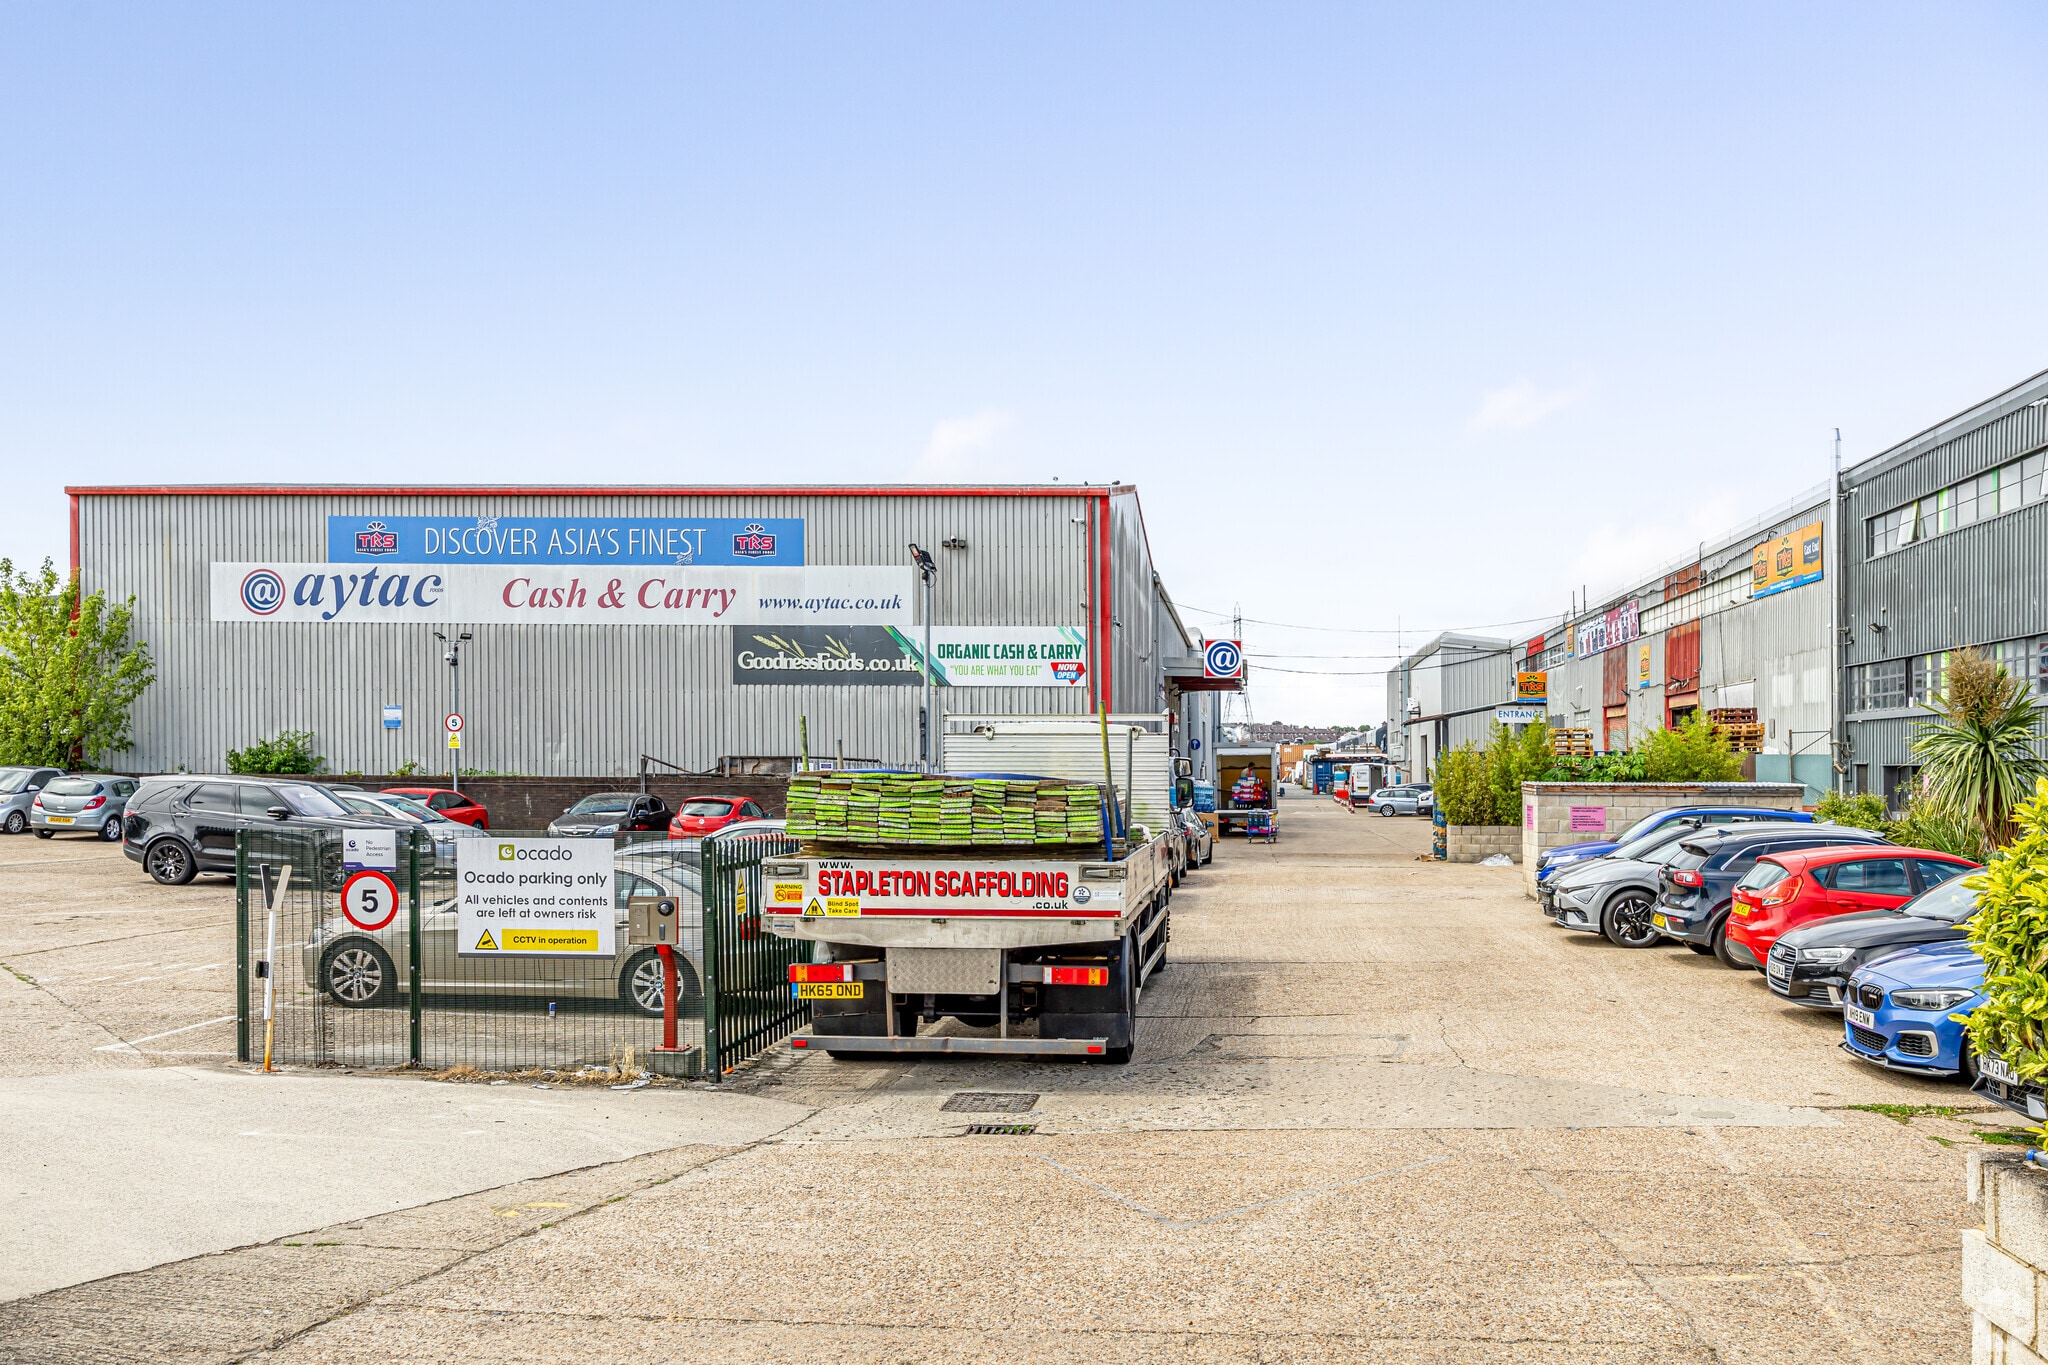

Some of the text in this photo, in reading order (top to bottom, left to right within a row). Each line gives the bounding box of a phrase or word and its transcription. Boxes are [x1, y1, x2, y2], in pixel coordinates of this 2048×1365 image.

[359, 532, 394, 547] TRS
[425, 527, 706, 556] DISCOVER ASIA'S FINEST
[737, 534, 772, 549] TRS
[294, 567, 442, 620] aytac
[503, 578, 736, 618] Cash & Carry
[759, 594, 902, 613] www.aytac.co.uk
[937, 643, 1082, 660] ORGANIC CASH & CARRY
[737, 651, 920, 672] GoodnessFoods.co.uk
[1058, 663, 1078, 671] NOW
[970, 665, 984, 676] ARE
[987, 665, 1007, 676] WHAT
[1010, 665, 1024, 676] YOU
[1056, 671, 1077, 679] OPEN
[1521, 682, 1543, 691] TRS
[1498, 710, 1543, 718] ENTRANCE
[451, 719, 457, 727] 5
[517, 845, 573, 861] ocado
[818, 861, 853, 869] www.
[464, 871, 607, 887] Ocado parking only
[818, 870, 931, 897] STAPLETON
[934, 870, 1068, 898] SCAFFOLDING
[361, 889, 379, 913] 5
[465, 895, 608, 906] All vehicles and contents
[1032, 900, 1068, 910] .co.uk
[476, 908, 597, 919] are left at owners risk
[513, 936, 587, 945] CCTV in operation
[800, 985, 861, 997] HK65 OND
[1983, 1059, 1999, 1075] HK73
